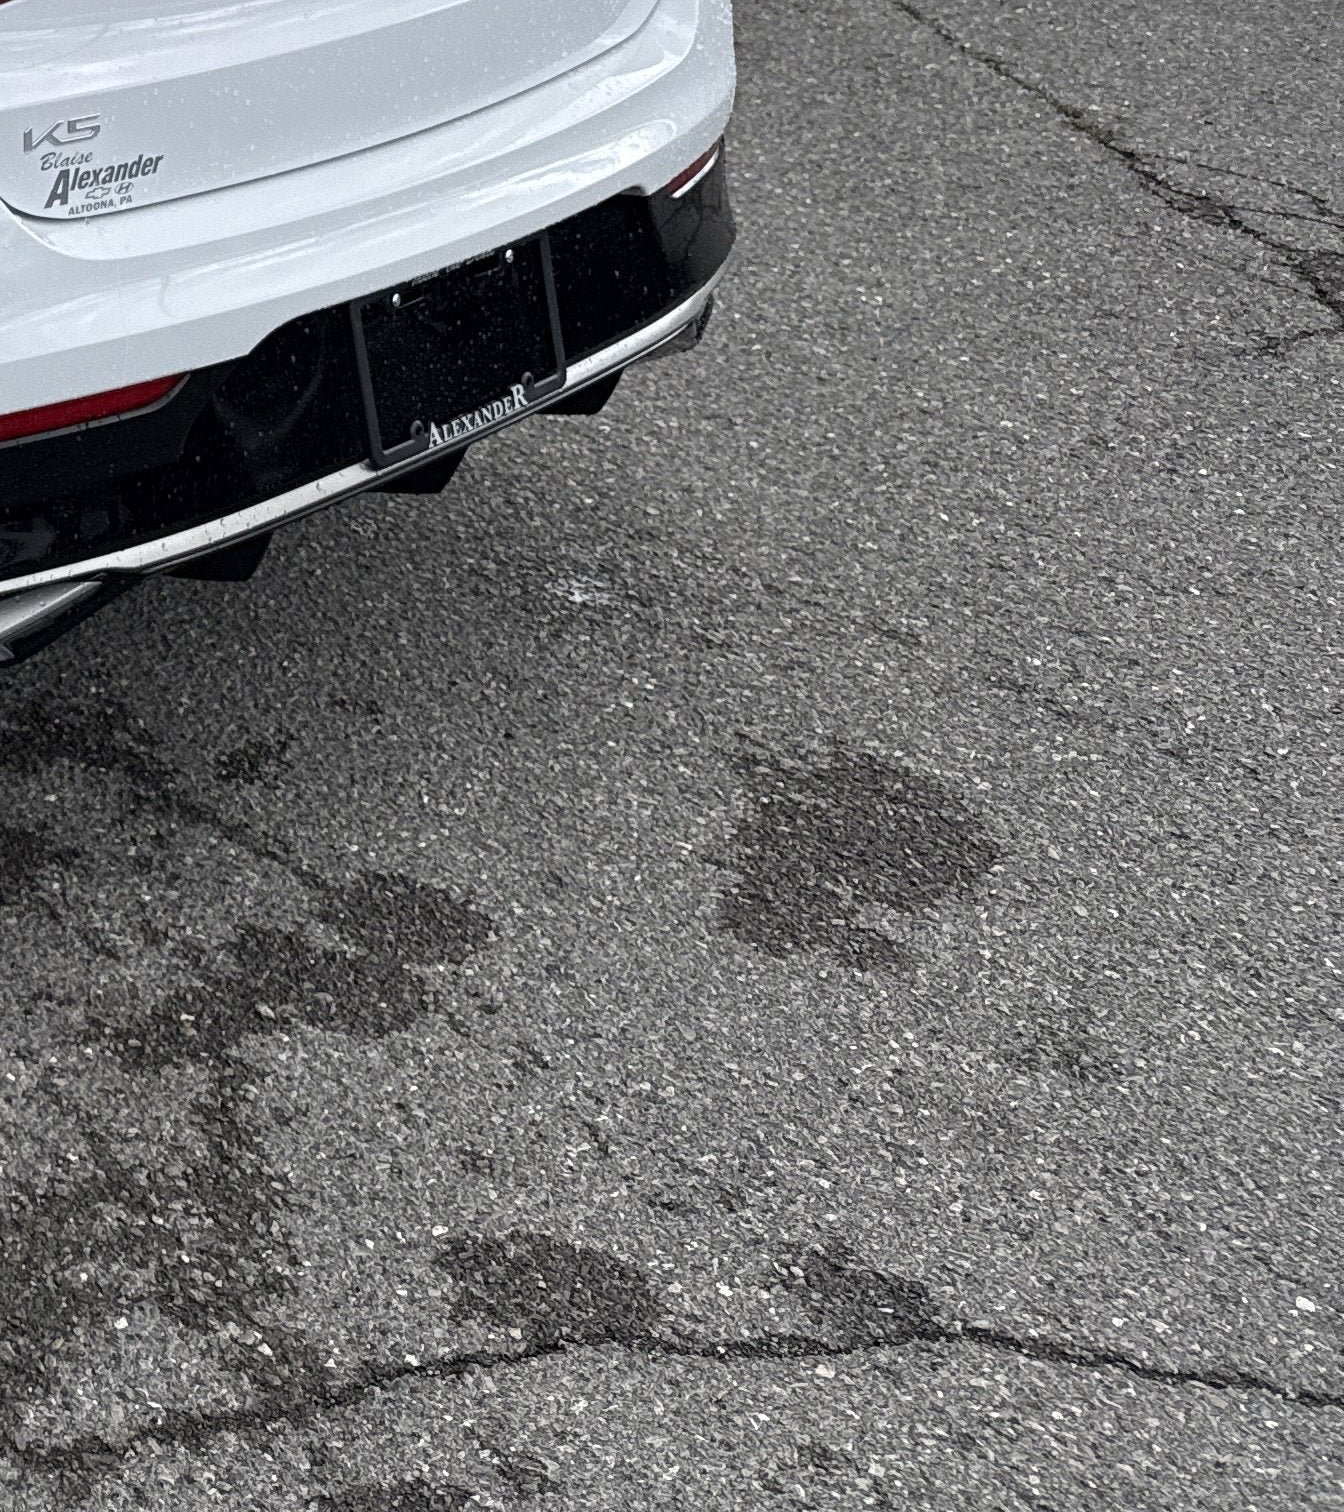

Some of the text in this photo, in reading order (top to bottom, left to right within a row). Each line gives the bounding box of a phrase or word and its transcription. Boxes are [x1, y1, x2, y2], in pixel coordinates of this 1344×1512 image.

[24, 113, 100, 152] K5
[40, 151, 94, 171] Blaise
[44, 154, 164, 209] Alexander
[68, 195, 132, 216] ALTOONA, PA
